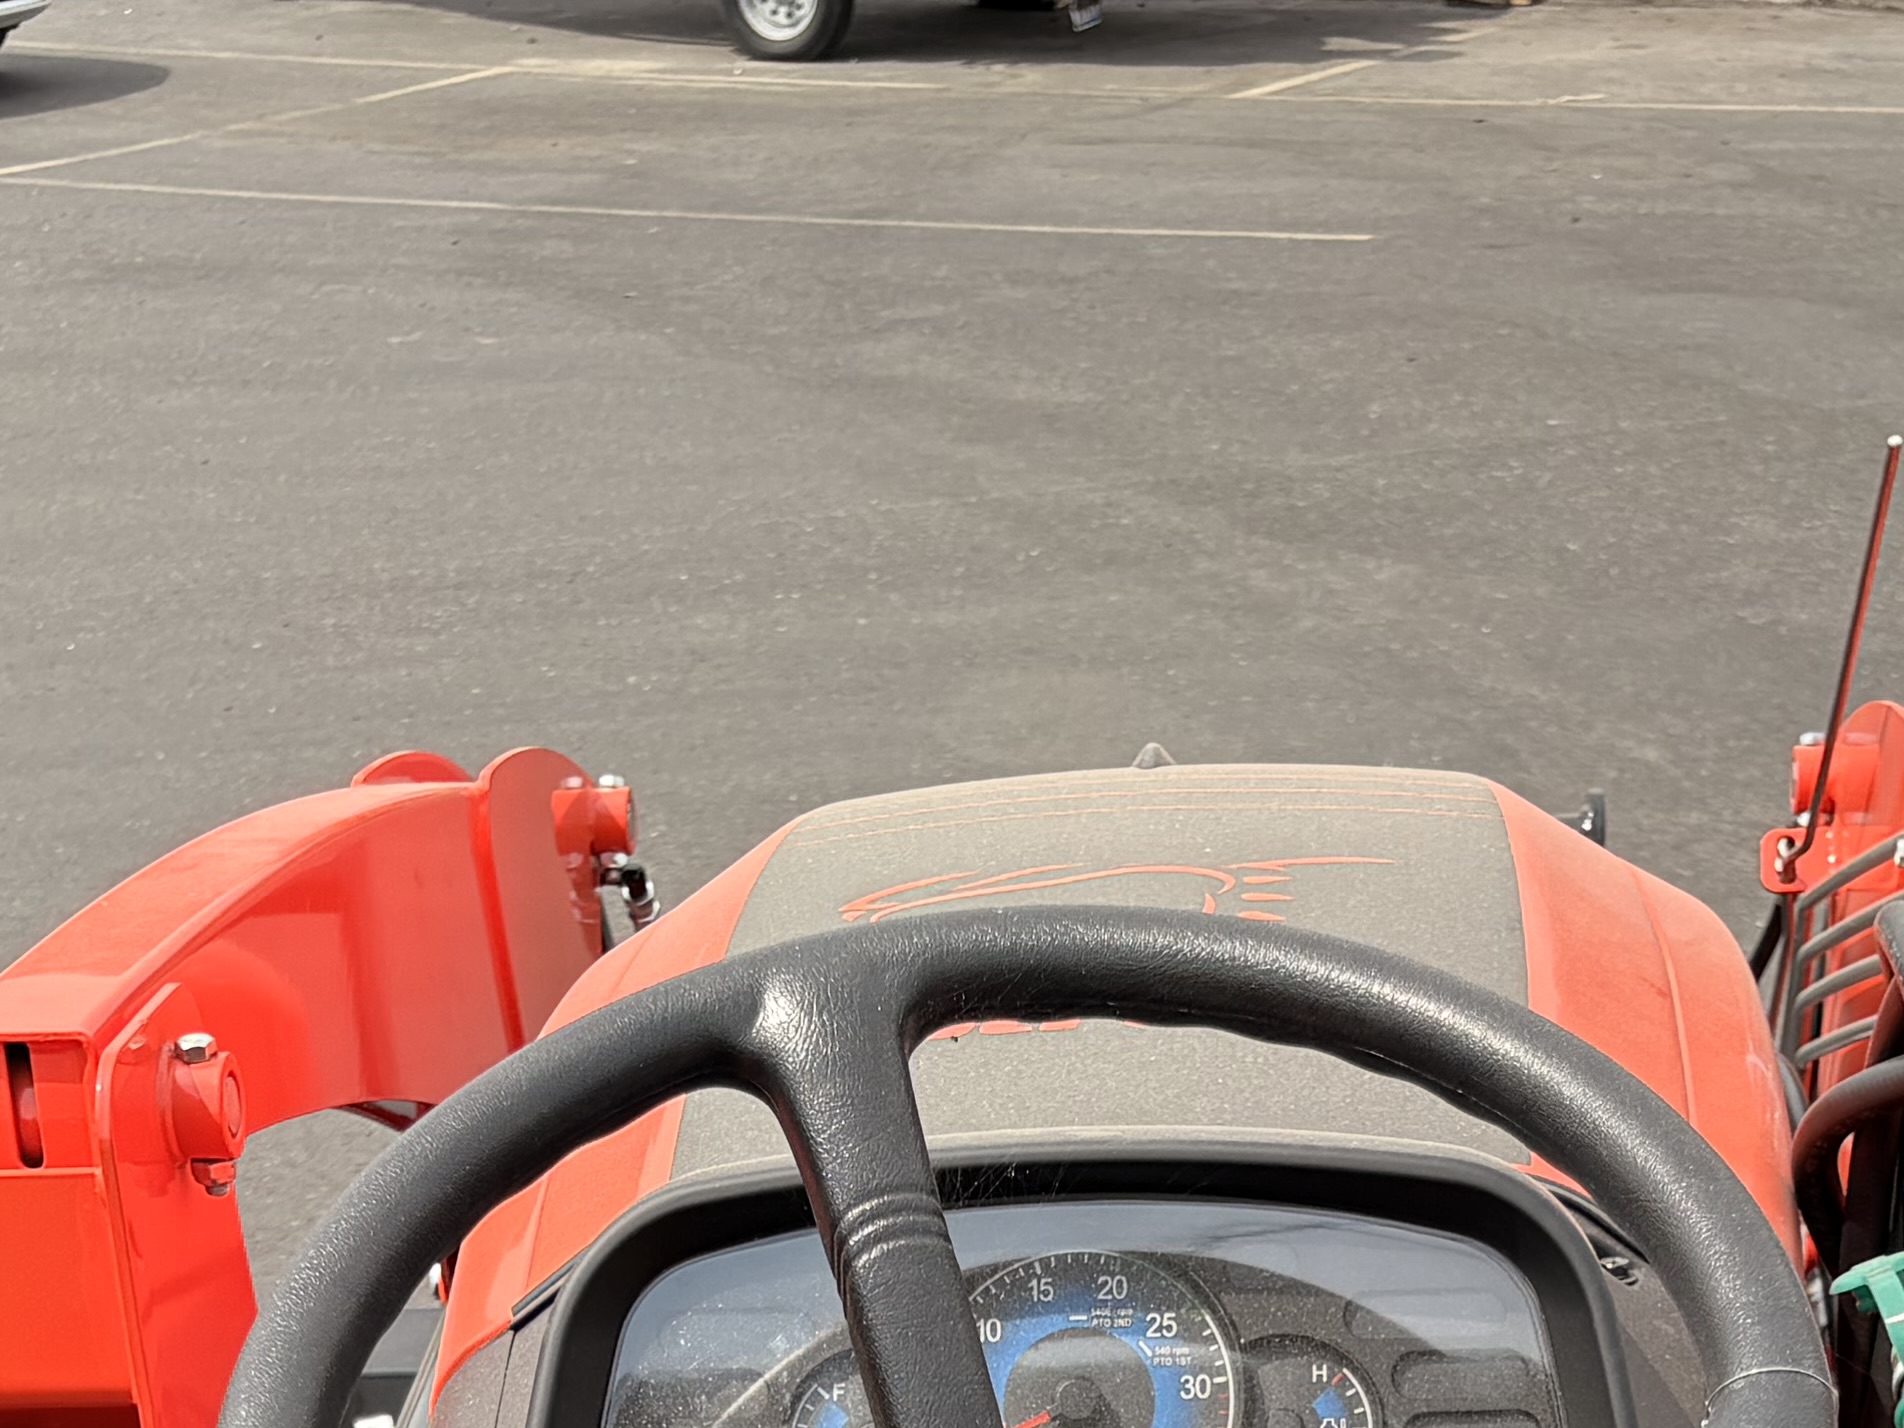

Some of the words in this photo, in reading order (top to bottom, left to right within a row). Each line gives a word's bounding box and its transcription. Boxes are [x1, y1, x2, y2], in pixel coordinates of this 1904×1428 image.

[1028, 1276, 1055, 1302] 15
[1097, 1275, 1128, 1301] 20
[976, 1318, 1002, 1343] 10
[1145, 1313, 1177, 1338] 25
[1153, 1357, 1173, 1367] PTO
[1311, 1365, 1328, 1383] H
[833, 1384, 846, 1401] F
[1180, 1375, 1212, 1399] 30
